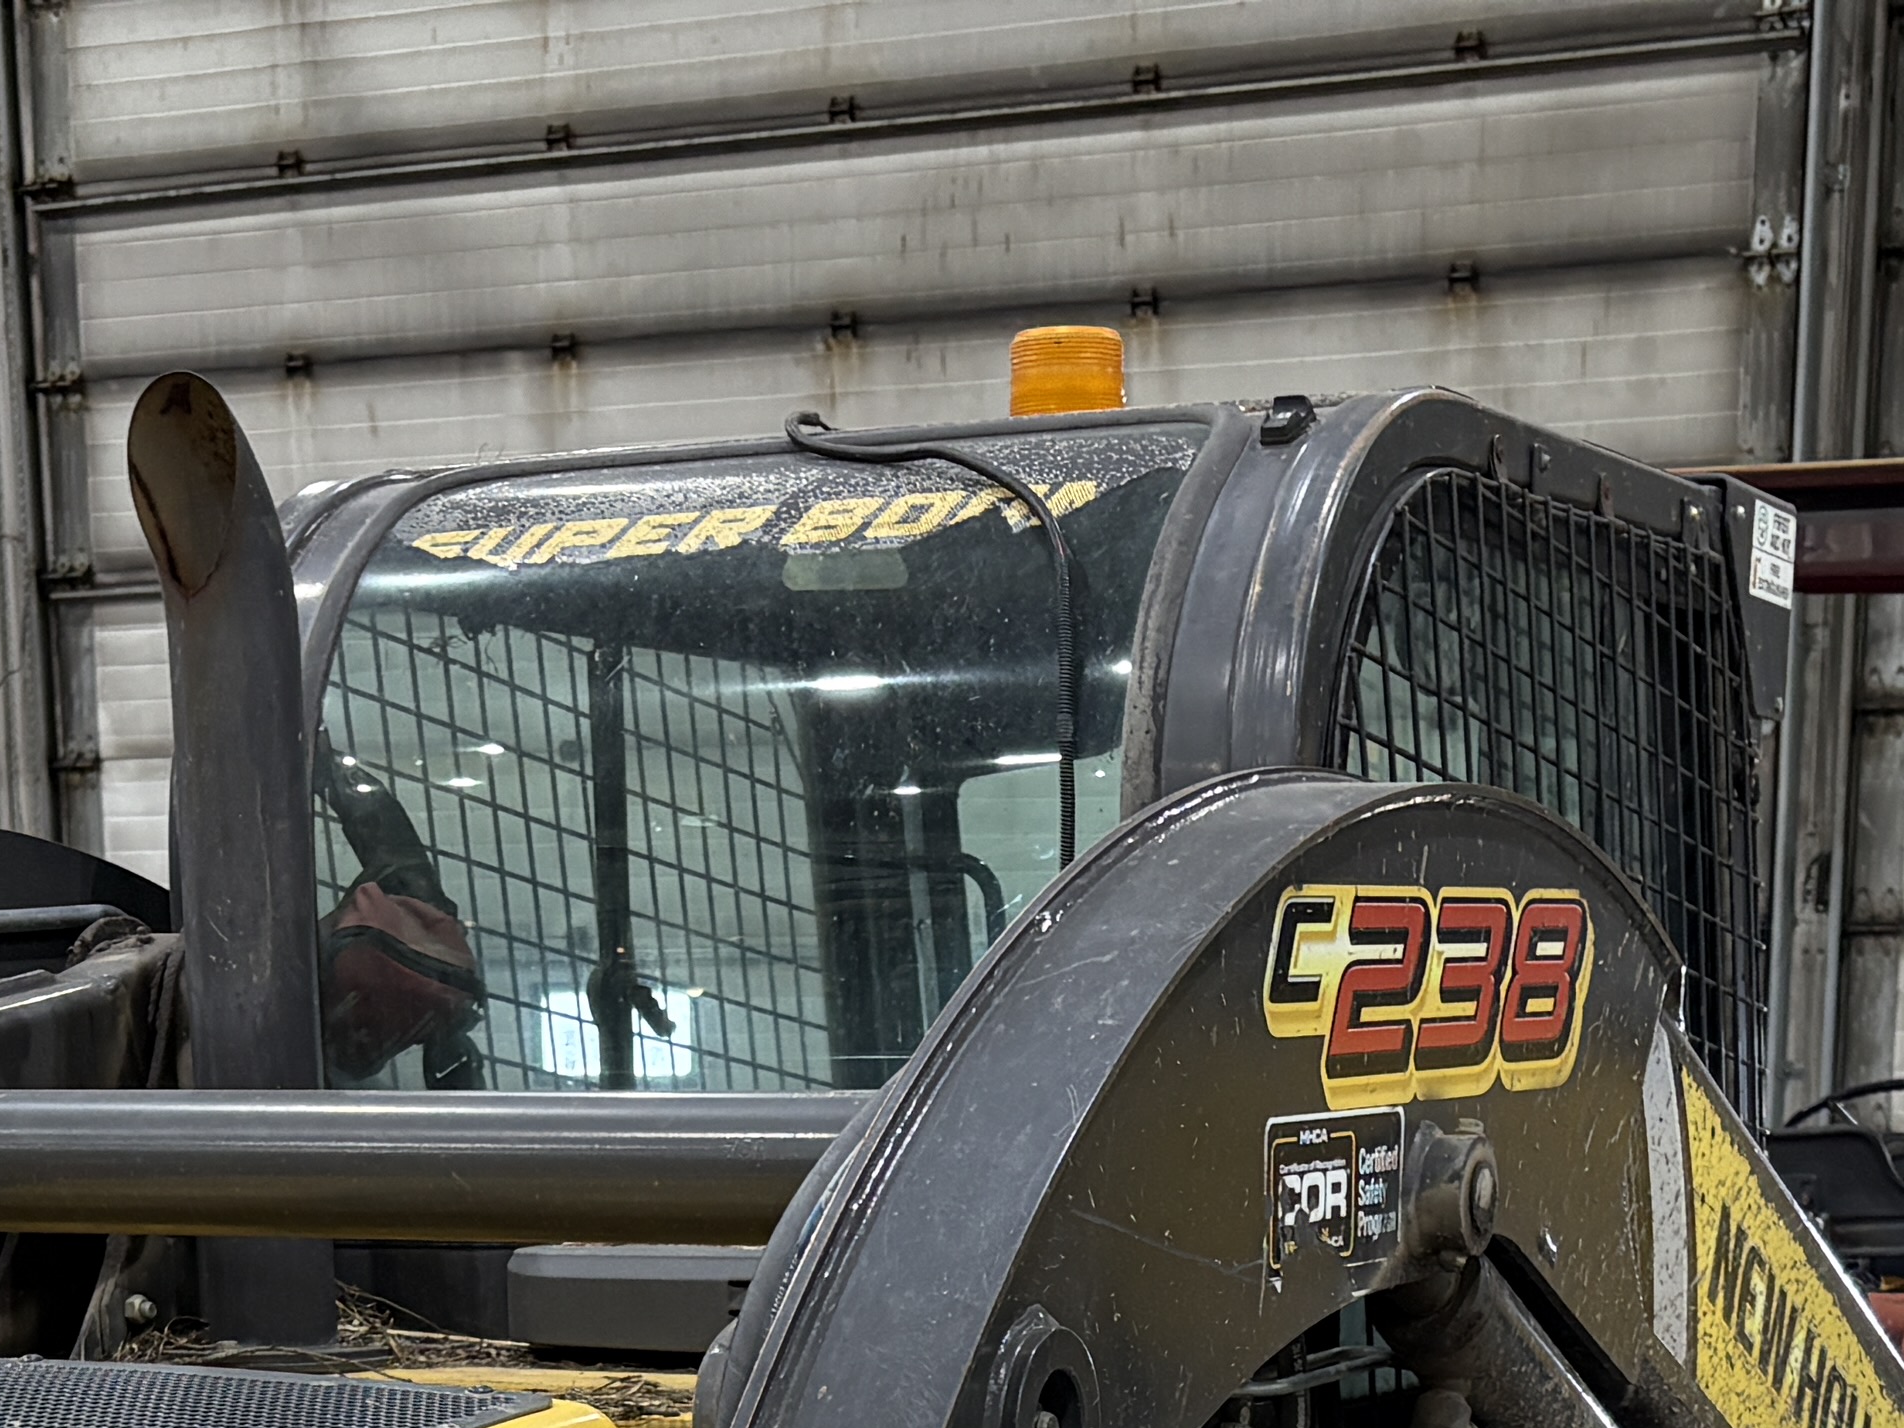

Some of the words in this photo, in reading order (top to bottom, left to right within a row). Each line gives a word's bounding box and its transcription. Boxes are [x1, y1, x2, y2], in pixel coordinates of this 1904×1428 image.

[410, 504, 778, 570] SUPER
[1358, 1144, 1400, 1175] Certified
[1358, 1177, 1389, 1209] Safety
[1357, 1210, 1396, 1243] Program
[1707, 1203, 1802, 1392] NEW
